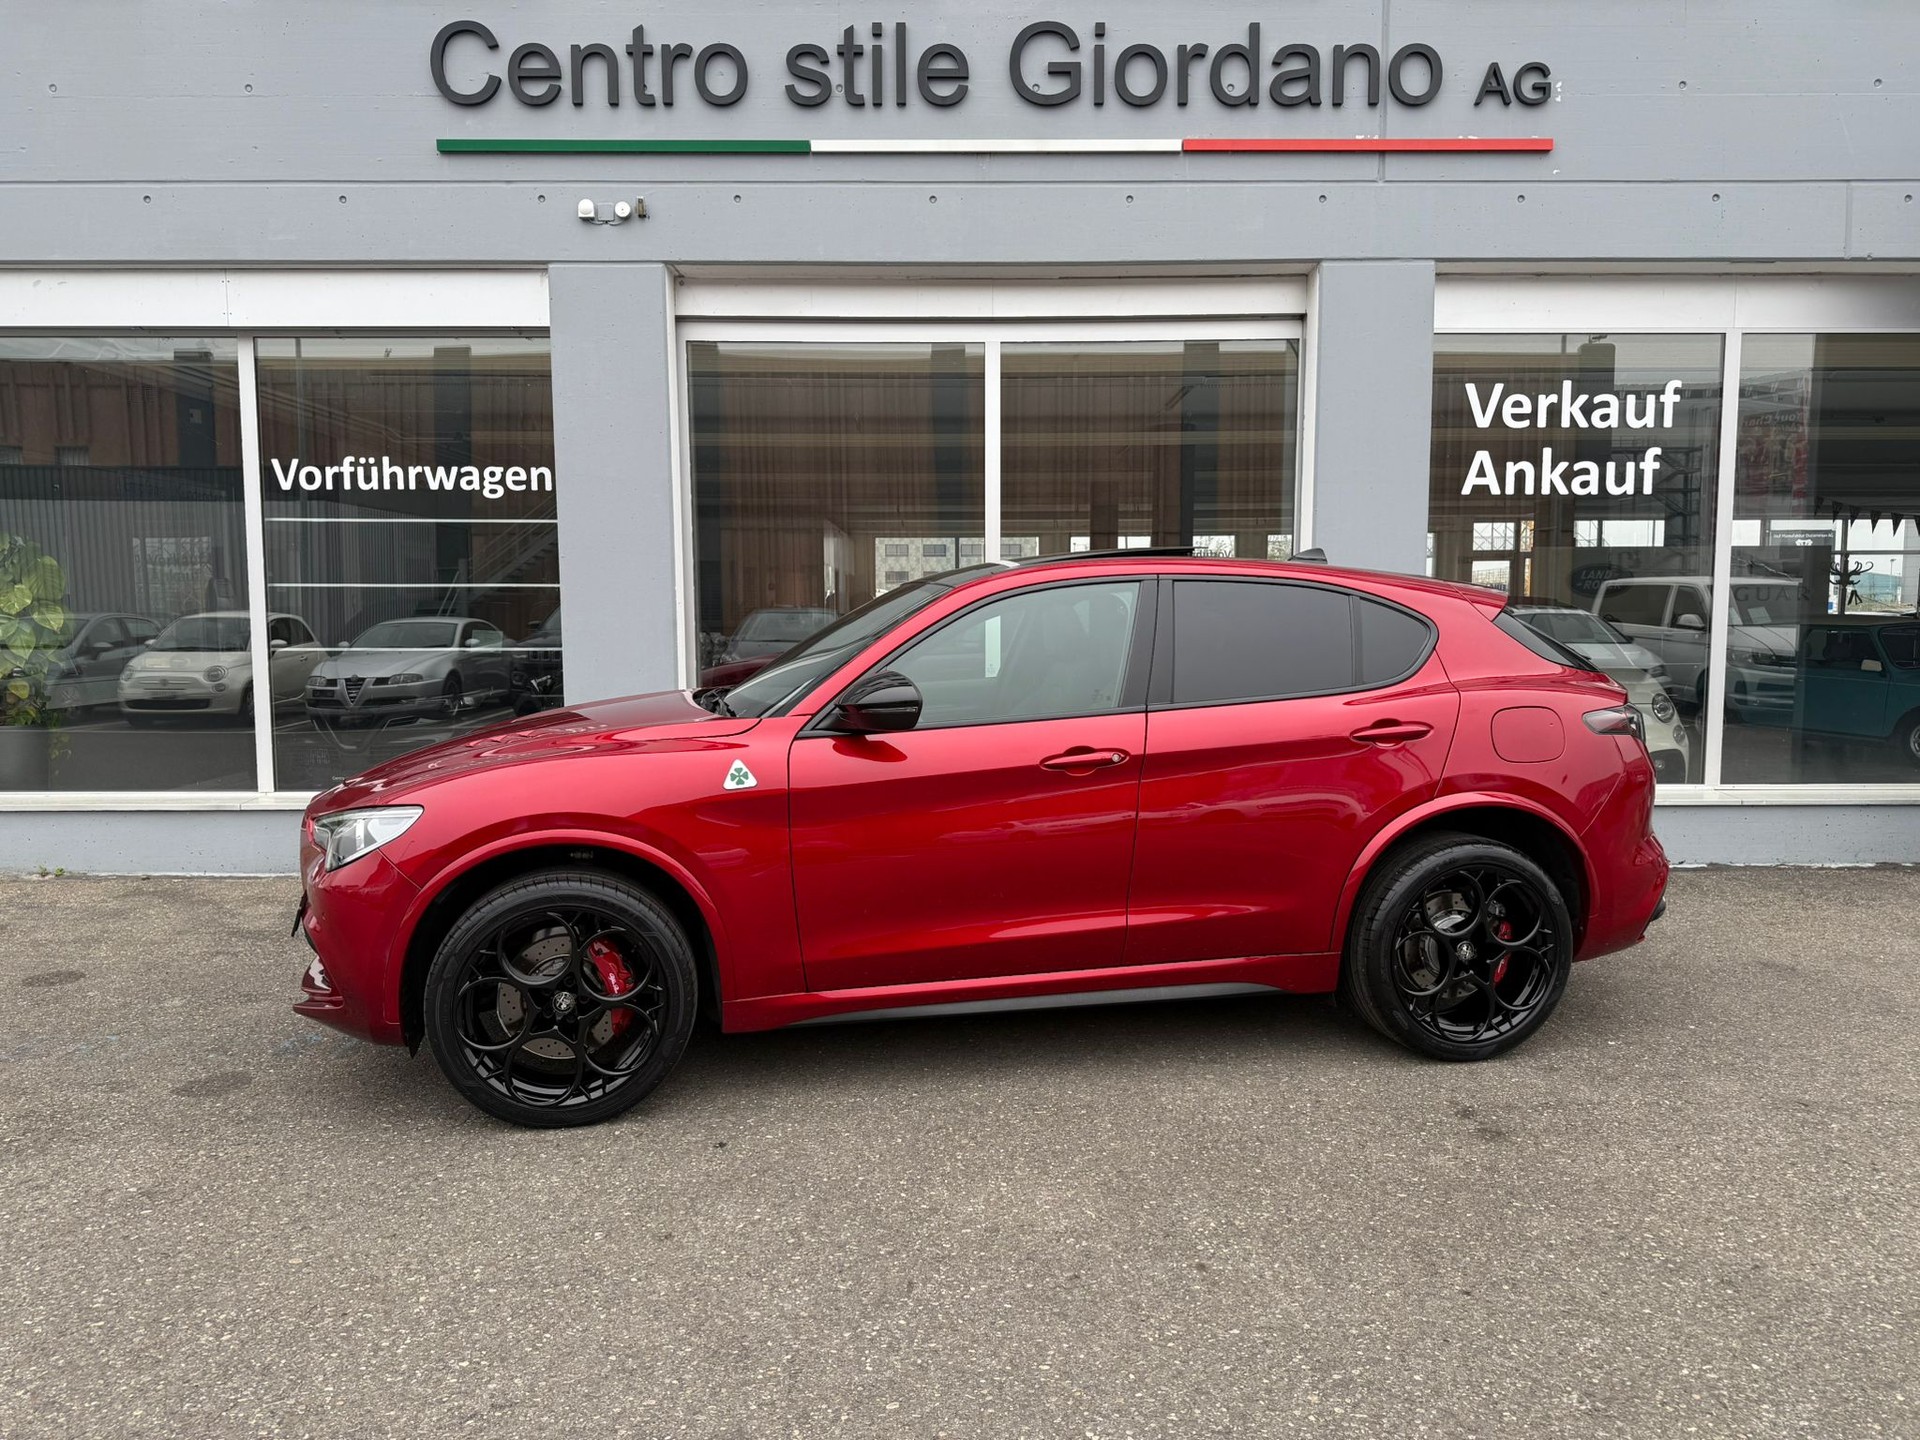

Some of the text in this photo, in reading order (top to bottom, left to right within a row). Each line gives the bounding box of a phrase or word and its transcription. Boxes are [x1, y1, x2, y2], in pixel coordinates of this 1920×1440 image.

[430, 20, 1552, 108] Centro stile Giordano AG
[1464, 379, 1682, 428] Verkauf
[271, 456, 552, 499] Vorführwagen
[1461, 447, 1661, 495] Ankauf
[1581, 569, 1612, 580] LAND
[1735, 586, 1810, 602] GUAR
